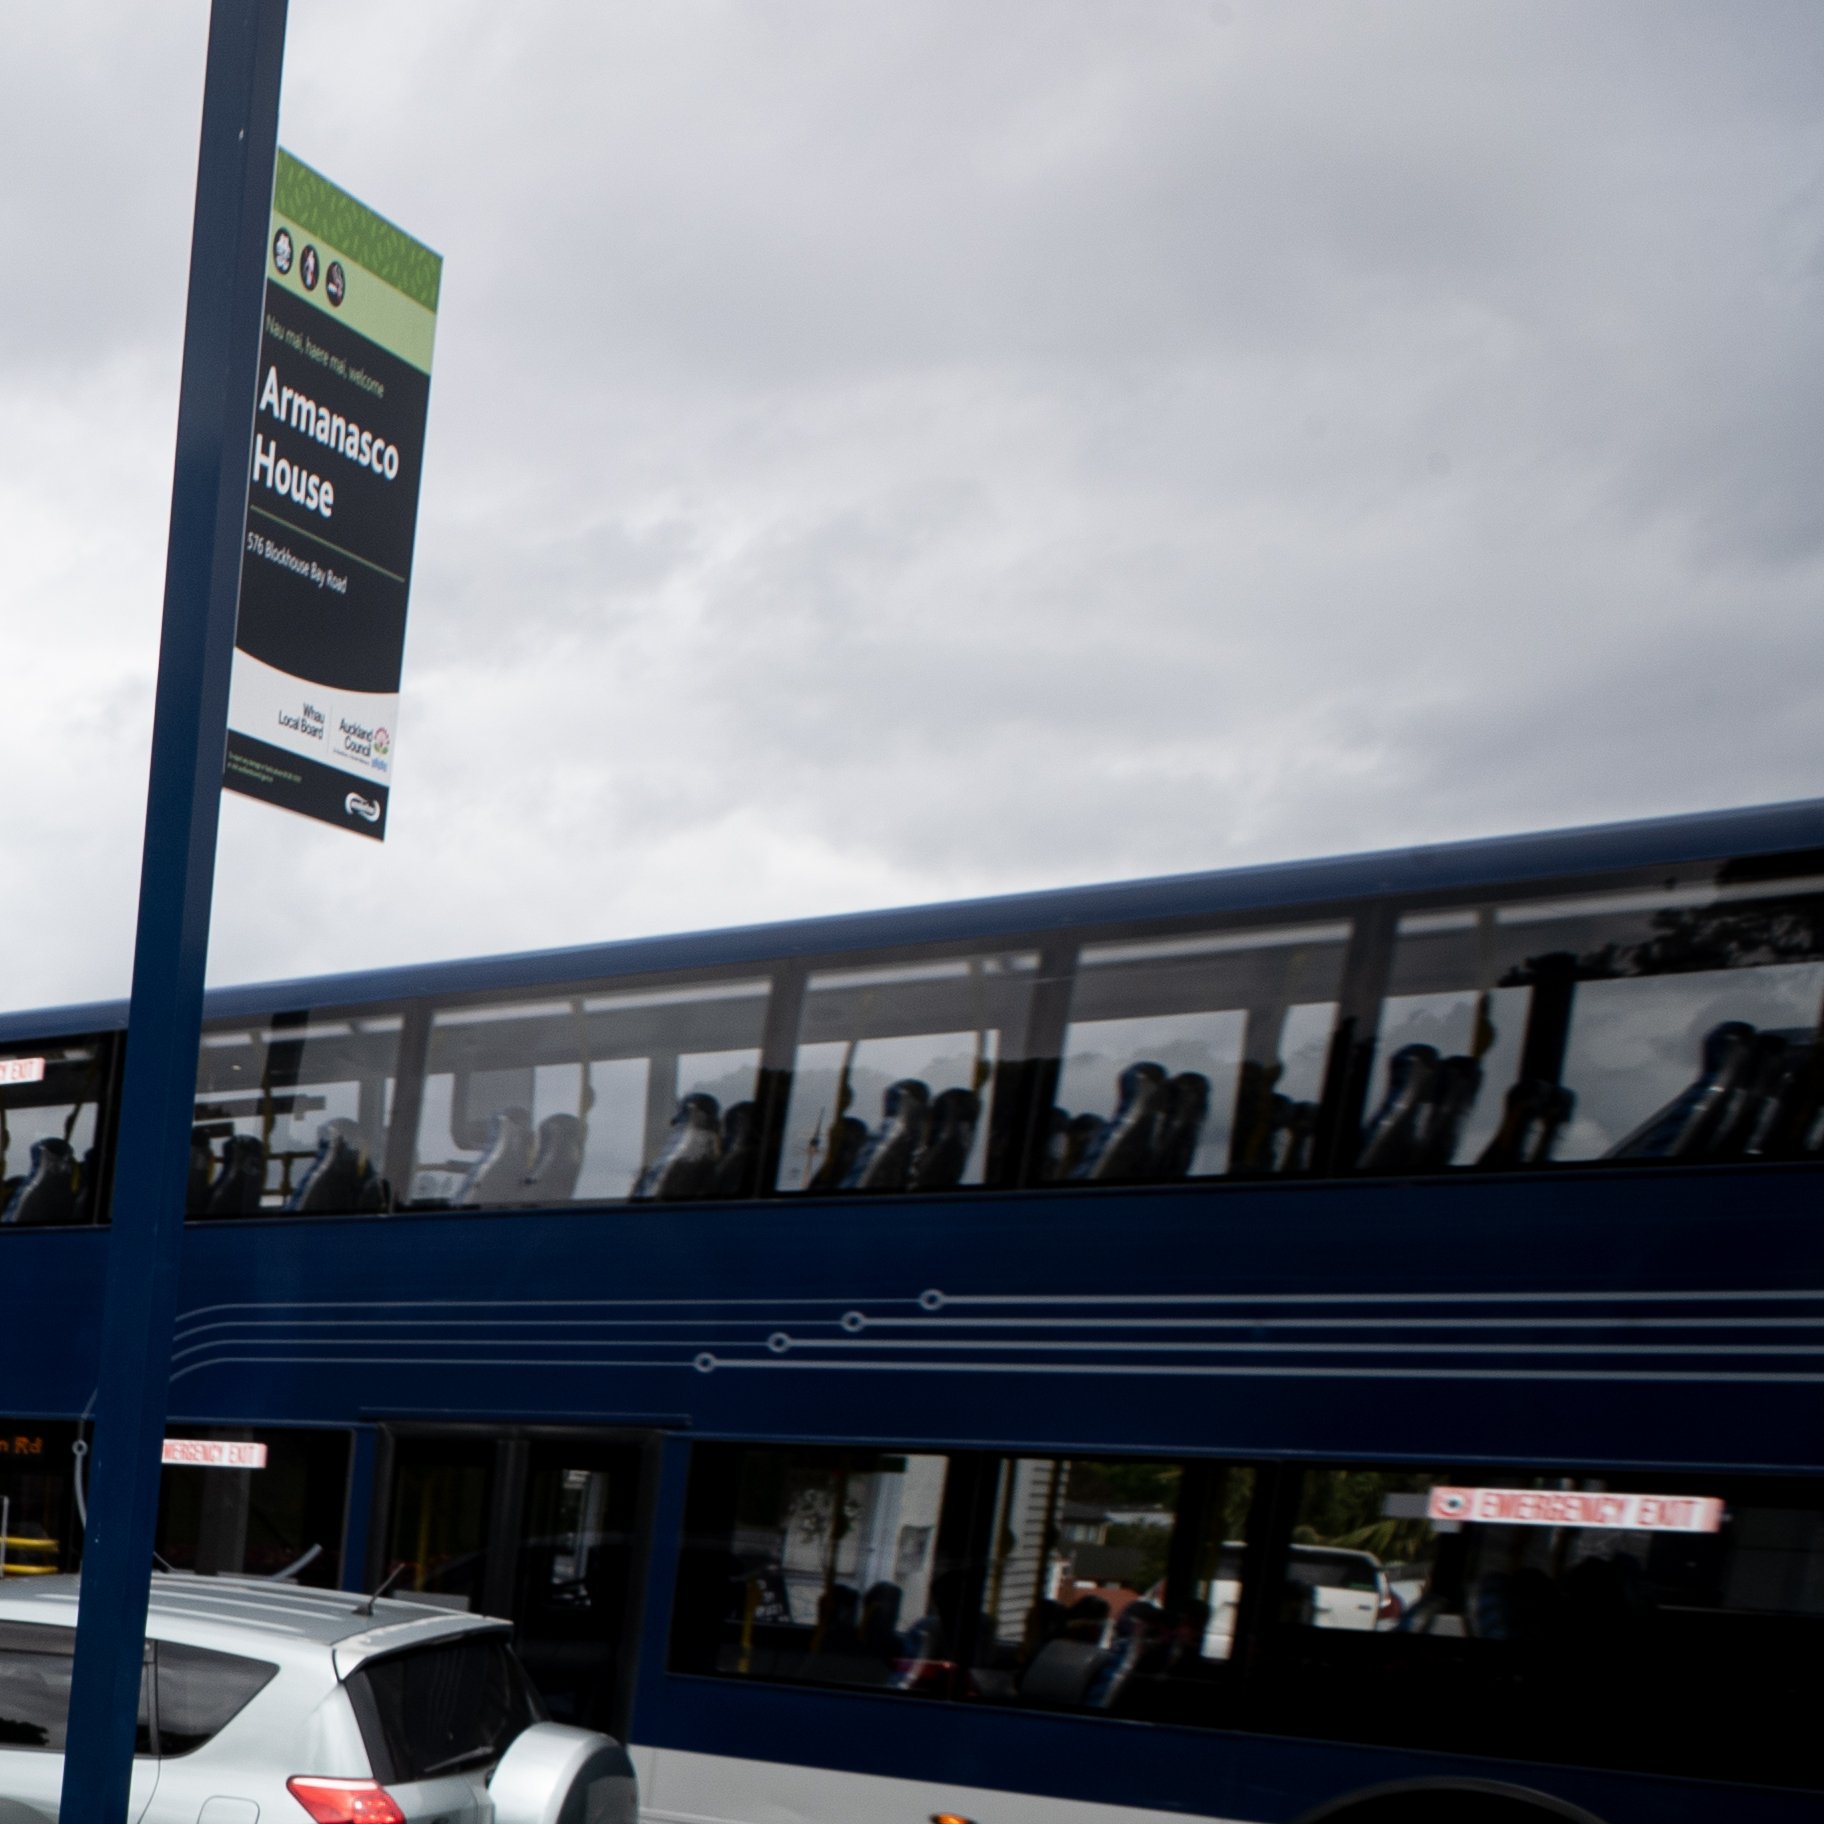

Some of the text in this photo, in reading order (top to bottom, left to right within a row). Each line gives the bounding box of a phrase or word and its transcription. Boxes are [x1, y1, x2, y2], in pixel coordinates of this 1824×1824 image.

[349, 367, 385, 399] welcome
[259, 365, 399, 480] Armanasco
[252, 434, 334, 517] House
[265, 540, 310, 577] Blockhouse
[310, 561, 326, 589] Bay
[327, 569, 348, 594] Road
[278, 710, 324, 740] Local Board
[302, 702, 325, 724] Whau
[339, 718, 372, 742] Auckland
[345, 735, 371, 757] Council
[11, 1061, 35, 1080] EXIT
[14, 1436, 44, 1455] Rd
[164, 1443, 256, 1464] MERGENCY EXIT
[1481, 1492, 1702, 1526] EMERGENCY EXIT
